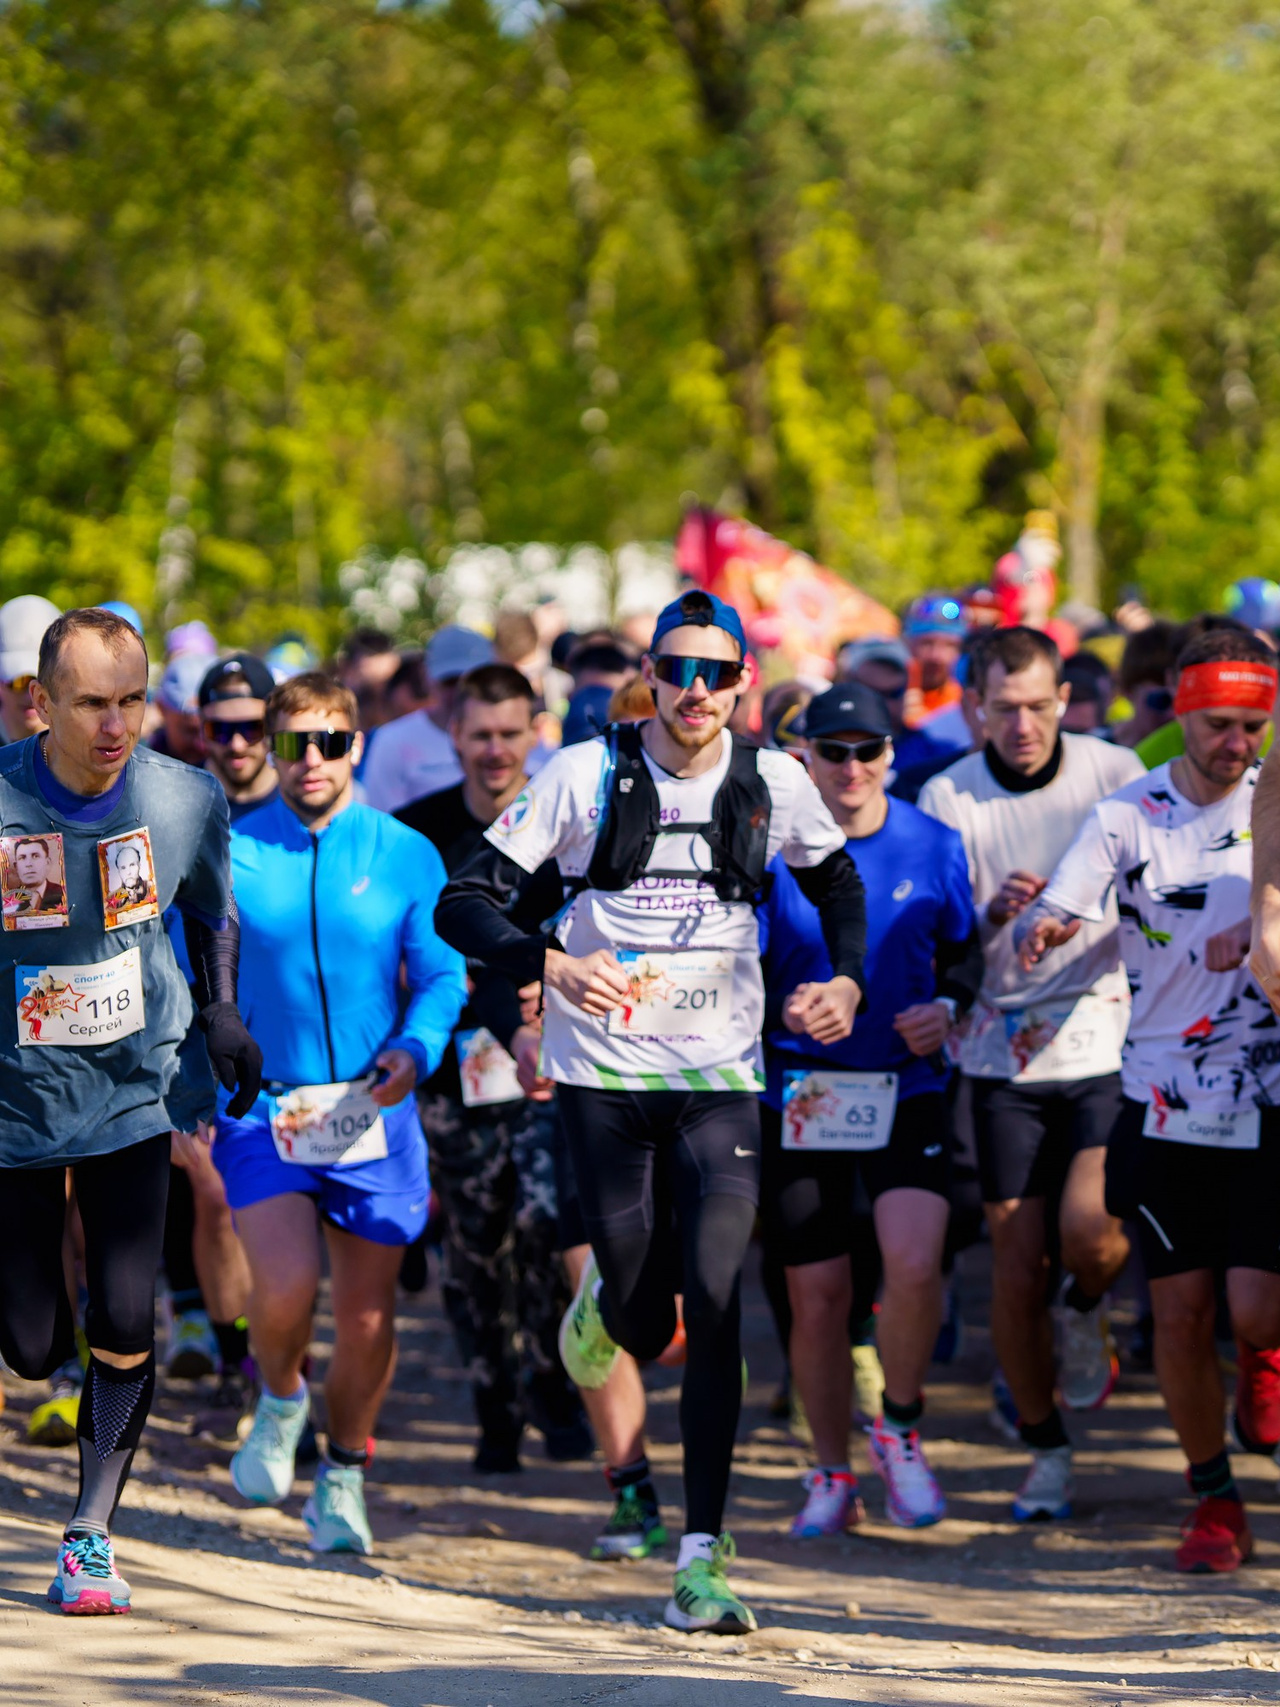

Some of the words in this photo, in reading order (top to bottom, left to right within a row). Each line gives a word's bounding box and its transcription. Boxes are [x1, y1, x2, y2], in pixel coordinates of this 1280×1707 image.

[74, 975, 104, 984] СПОРТ
[86, 989, 130, 1019] 118
[673, 988, 719, 1010] 201
[68, 1016, 123, 1037] Сергей
[327, 1112, 372, 1138] 104
[845, 1104, 878, 1127] 63
